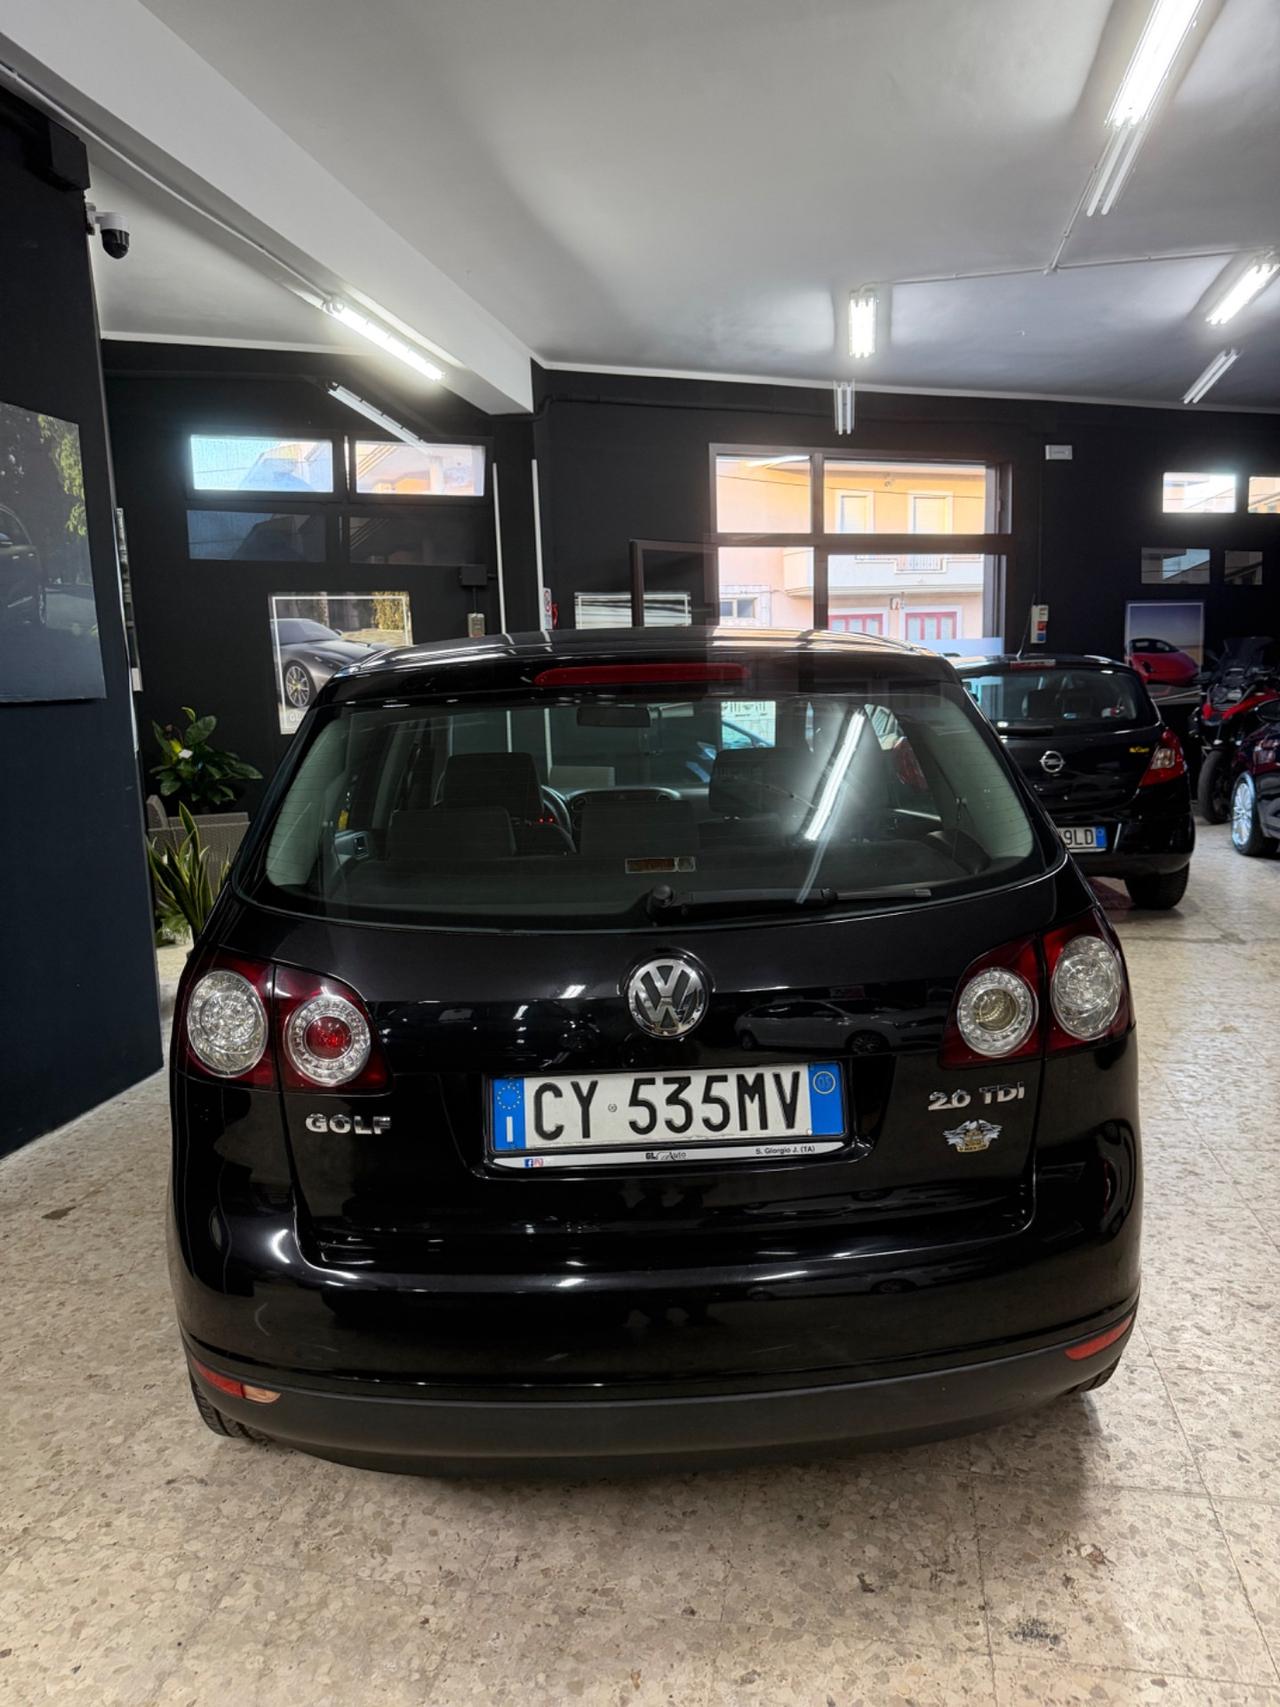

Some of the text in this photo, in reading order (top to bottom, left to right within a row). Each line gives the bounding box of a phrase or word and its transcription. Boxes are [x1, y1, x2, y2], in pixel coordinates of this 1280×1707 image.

[1061, 829, 1094, 847] 9LD
[979, 1081, 1025, 1104] TDI
[534, 1071, 800, 1141] CY 535MV
[305, 1113, 391, 1135] GOLF
